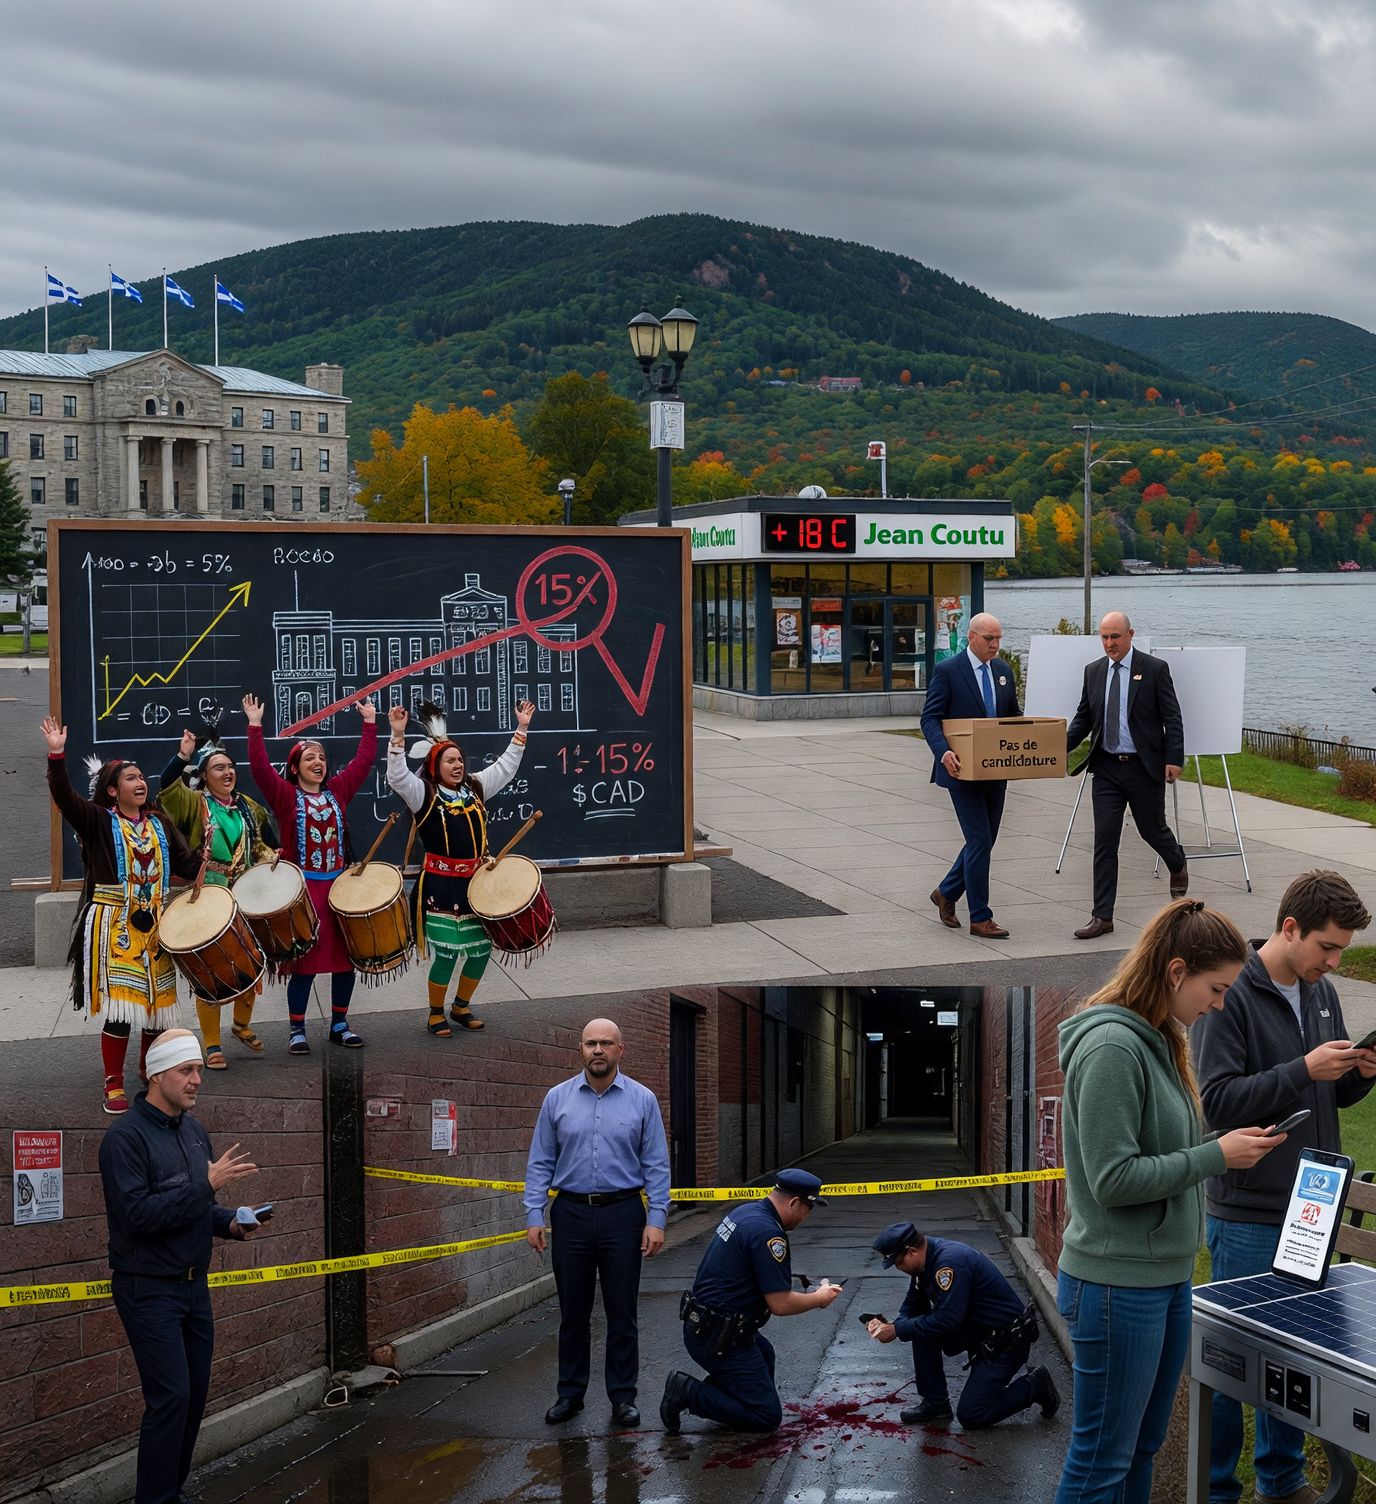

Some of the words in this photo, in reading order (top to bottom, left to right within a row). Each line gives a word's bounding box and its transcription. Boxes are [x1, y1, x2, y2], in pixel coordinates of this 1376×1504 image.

[863, 522, 924, 546] Jean
[929, 522, 1005, 546] Coutu
[999, 739, 1020, 752] Pas
[1022, 739, 1038, 751] de
